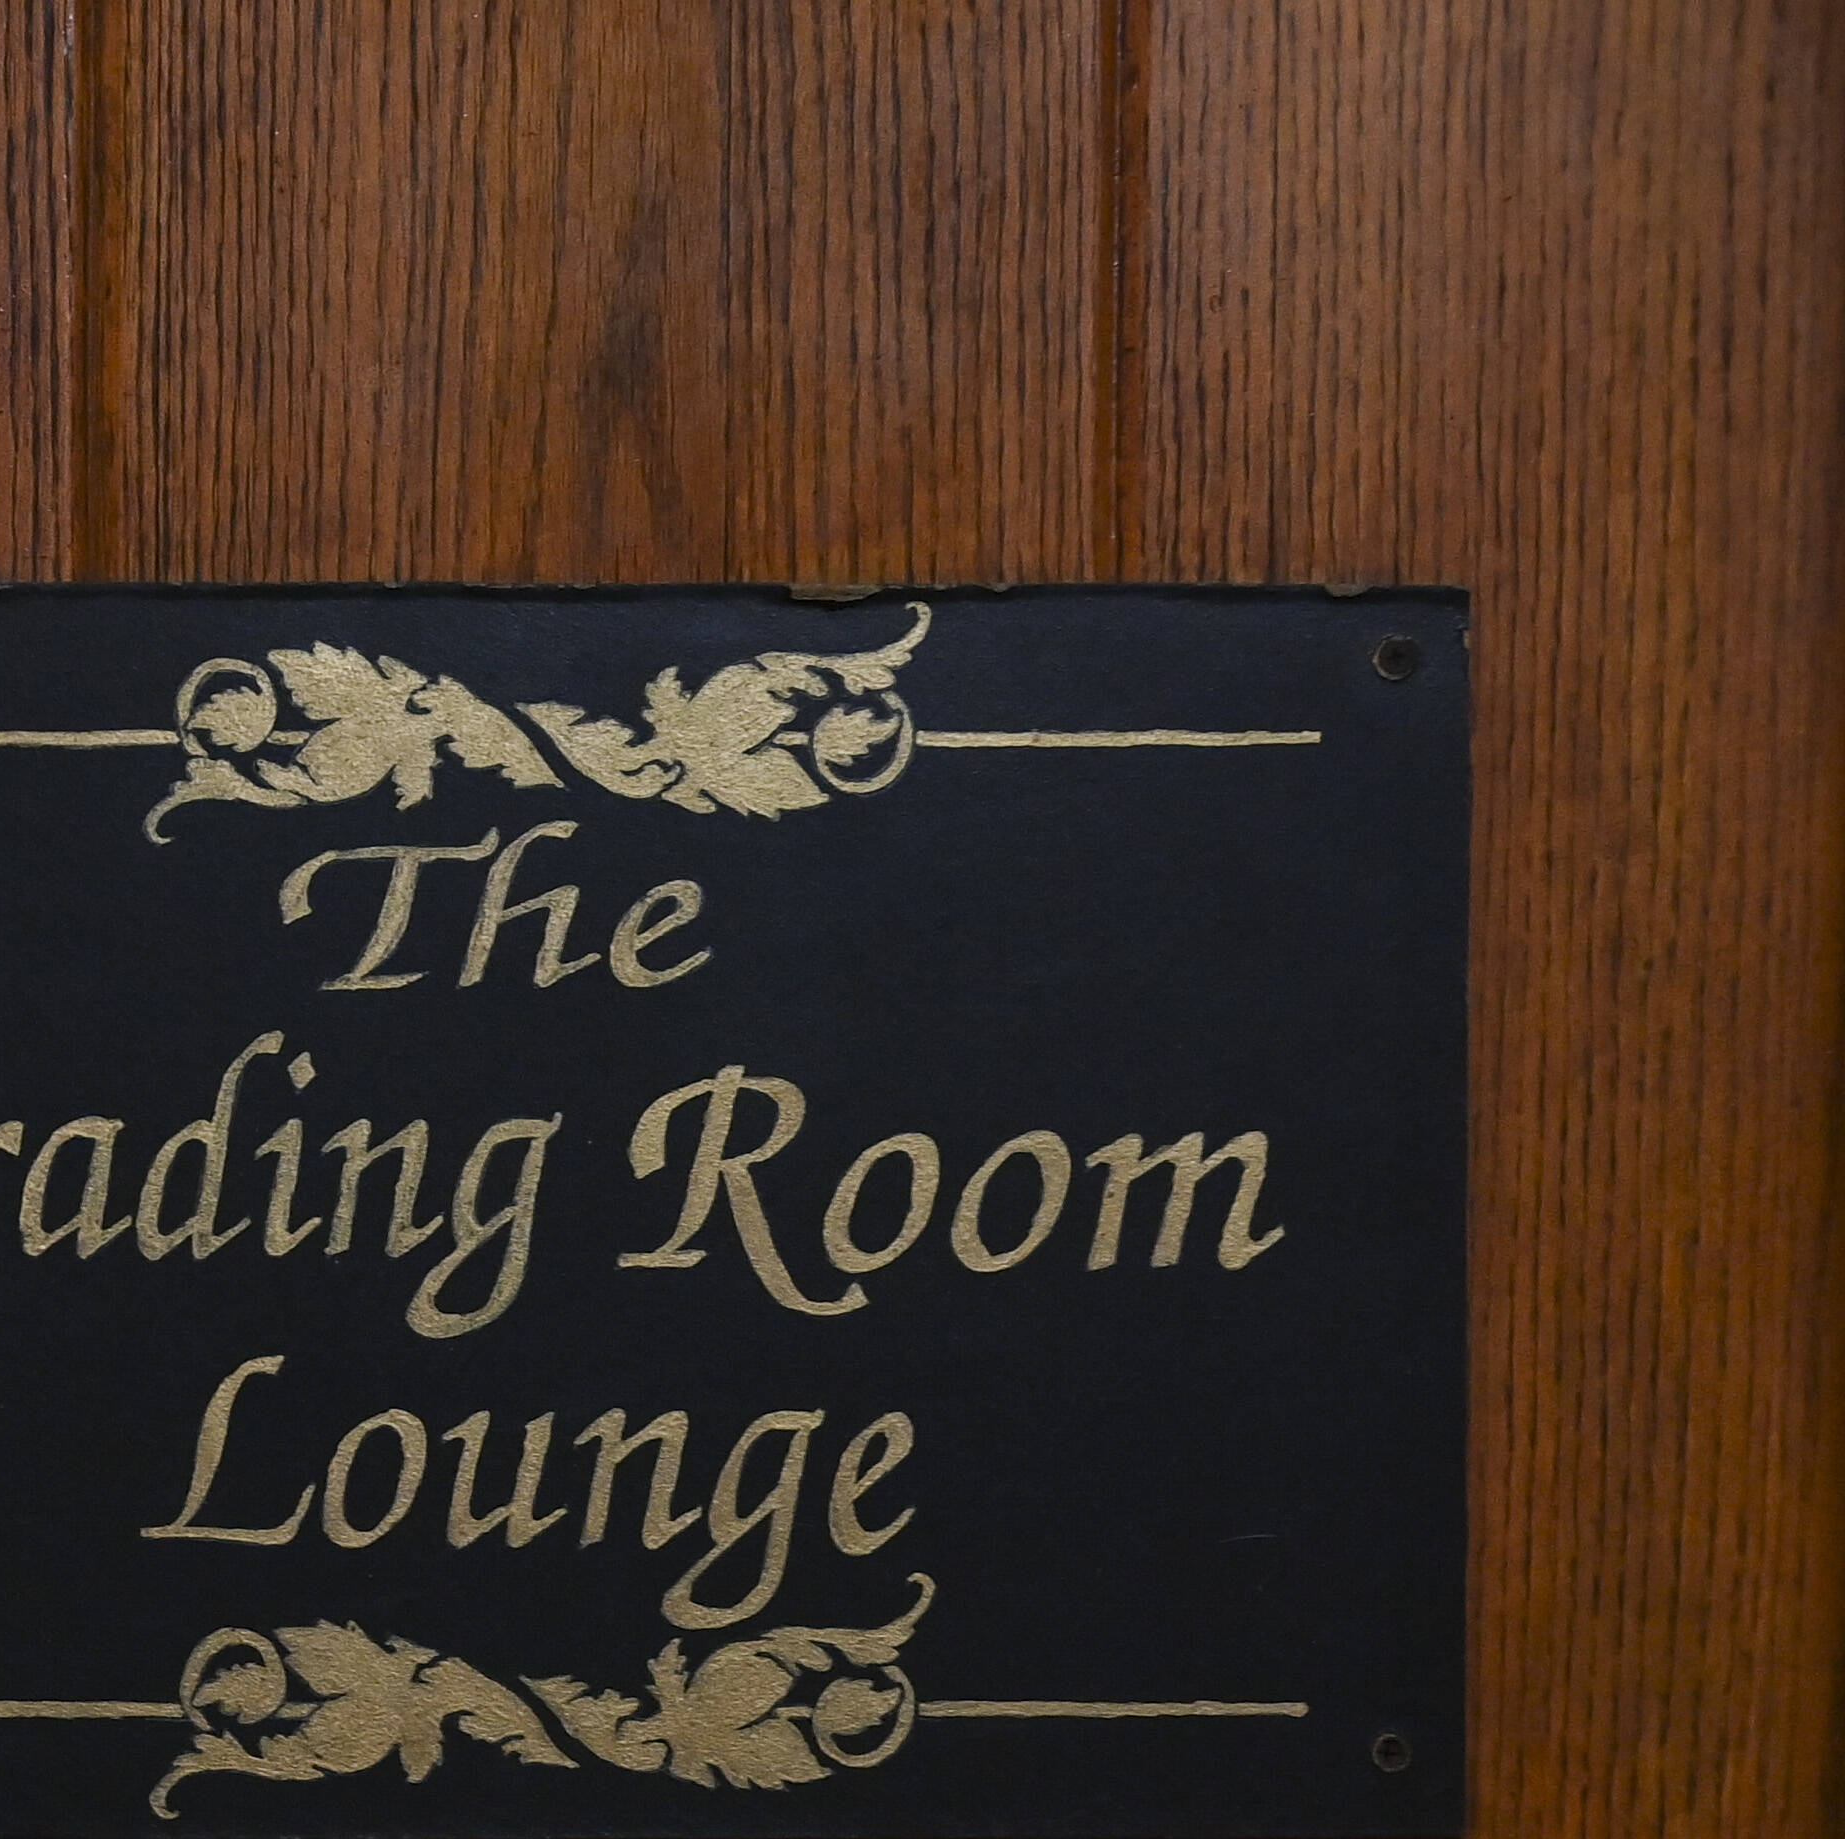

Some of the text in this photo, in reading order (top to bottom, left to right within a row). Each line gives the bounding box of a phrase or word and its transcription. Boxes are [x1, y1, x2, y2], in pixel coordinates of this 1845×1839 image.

[278, 820, 712, 991] The
[617, 1064, 1285, 1316] Room
[140, 1354, 918, 1631] Lounge
